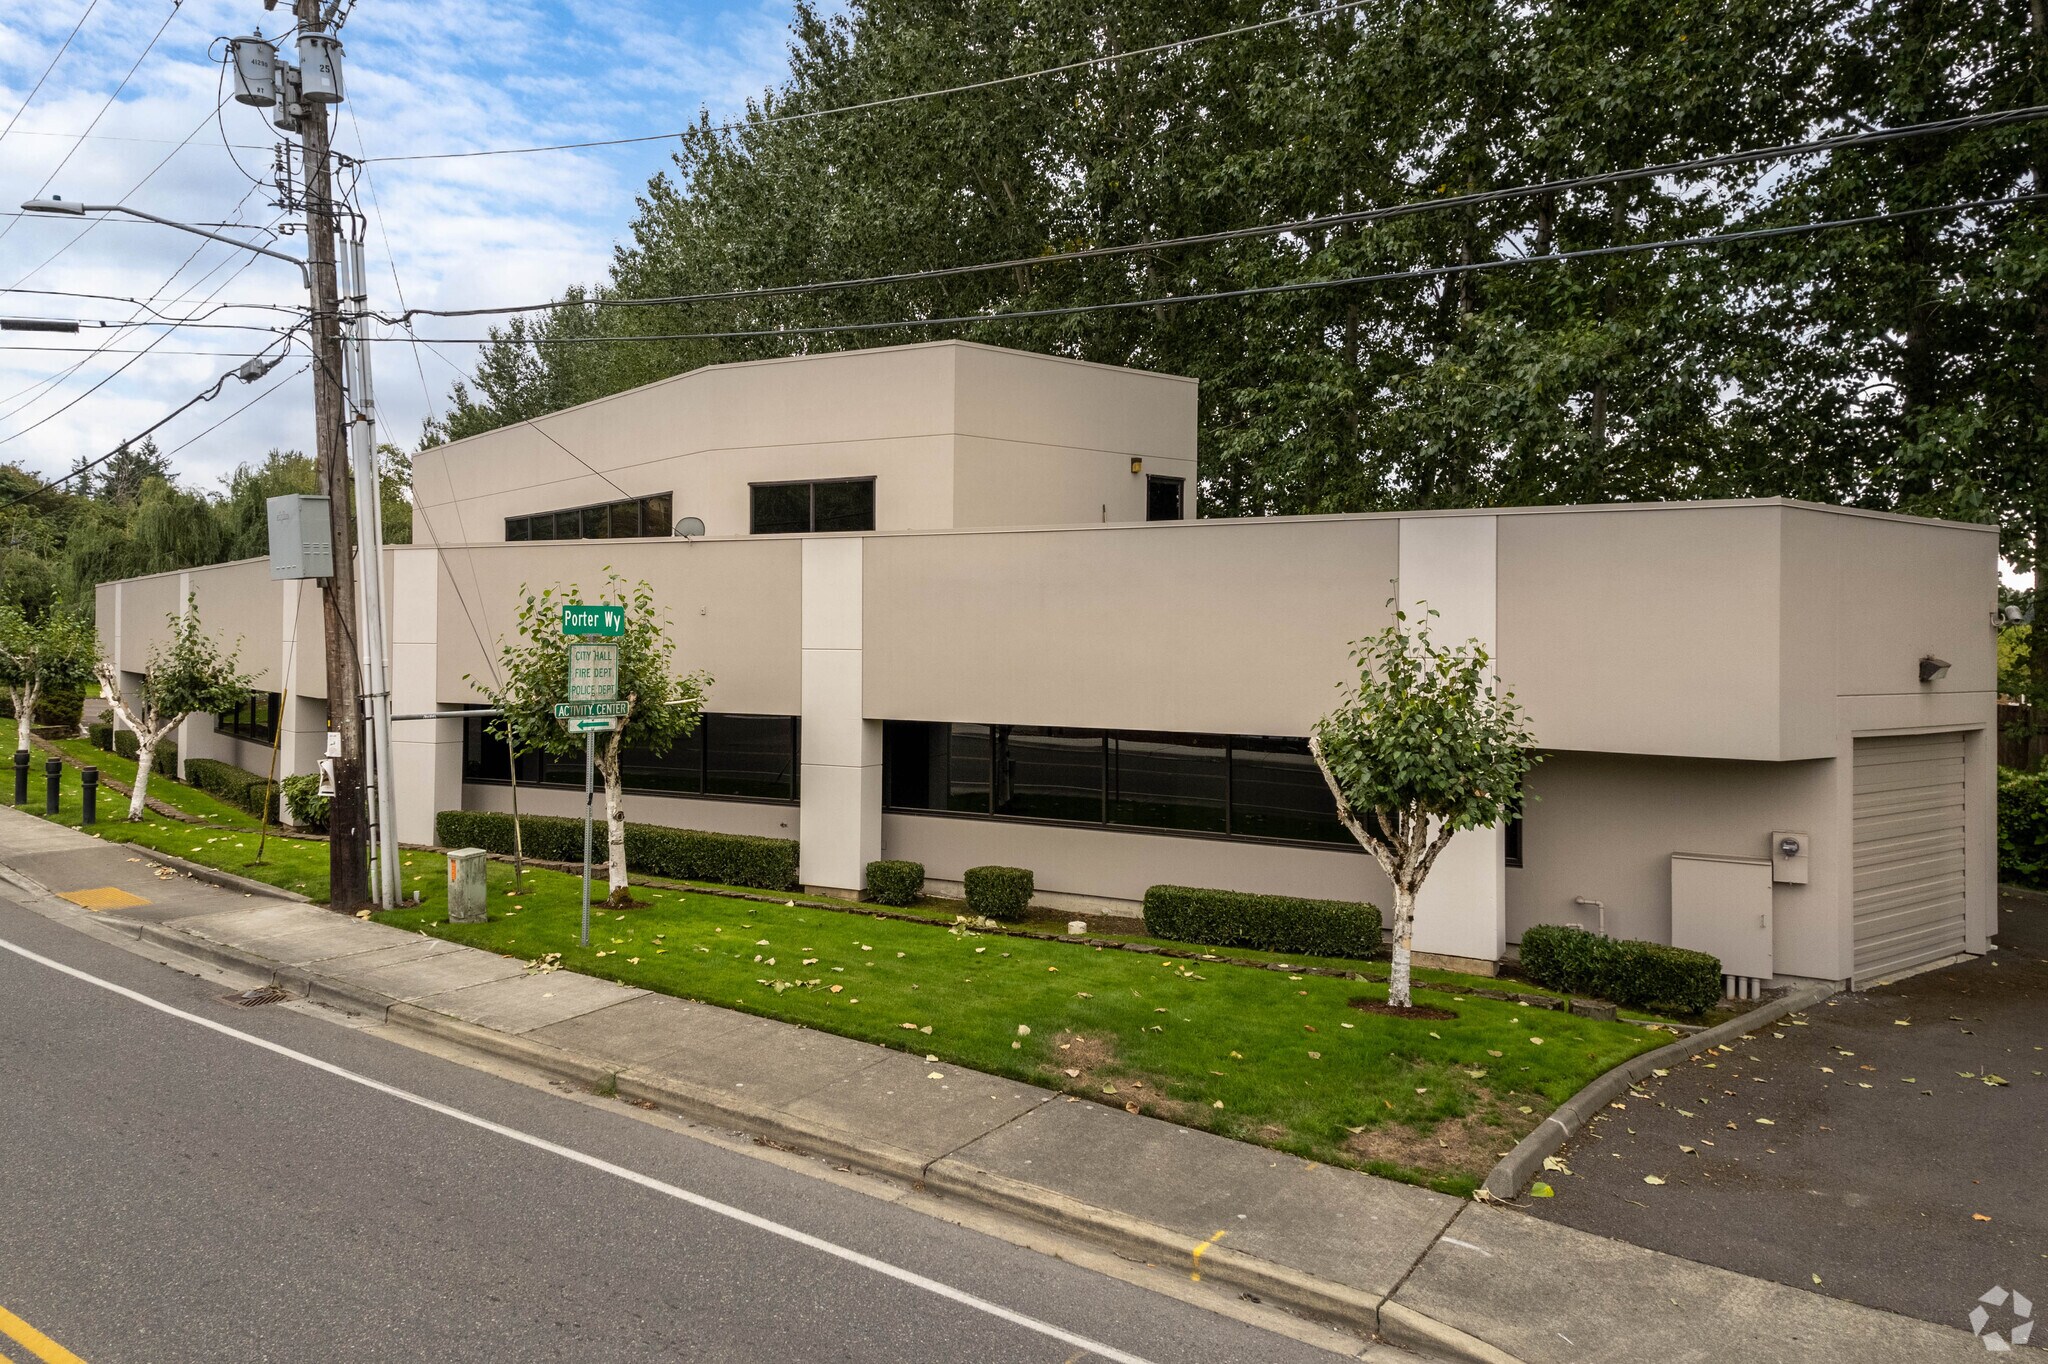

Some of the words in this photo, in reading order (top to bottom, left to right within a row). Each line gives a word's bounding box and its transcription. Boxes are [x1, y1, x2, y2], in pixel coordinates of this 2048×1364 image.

[319, 64, 331, 73] 25
[565, 610, 599, 627] Porter
[604, 611, 621, 632] Wy
[575, 651, 591, 661] CITY
[594, 651, 612, 661] HALL
[575, 668, 591, 678] FIRE
[593, 668, 612, 678] DEPT
[571, 685, 595, 695] POLICE
[598, 684, 615, 695] DEPT
[596, 703, 626, 715] CENTER
